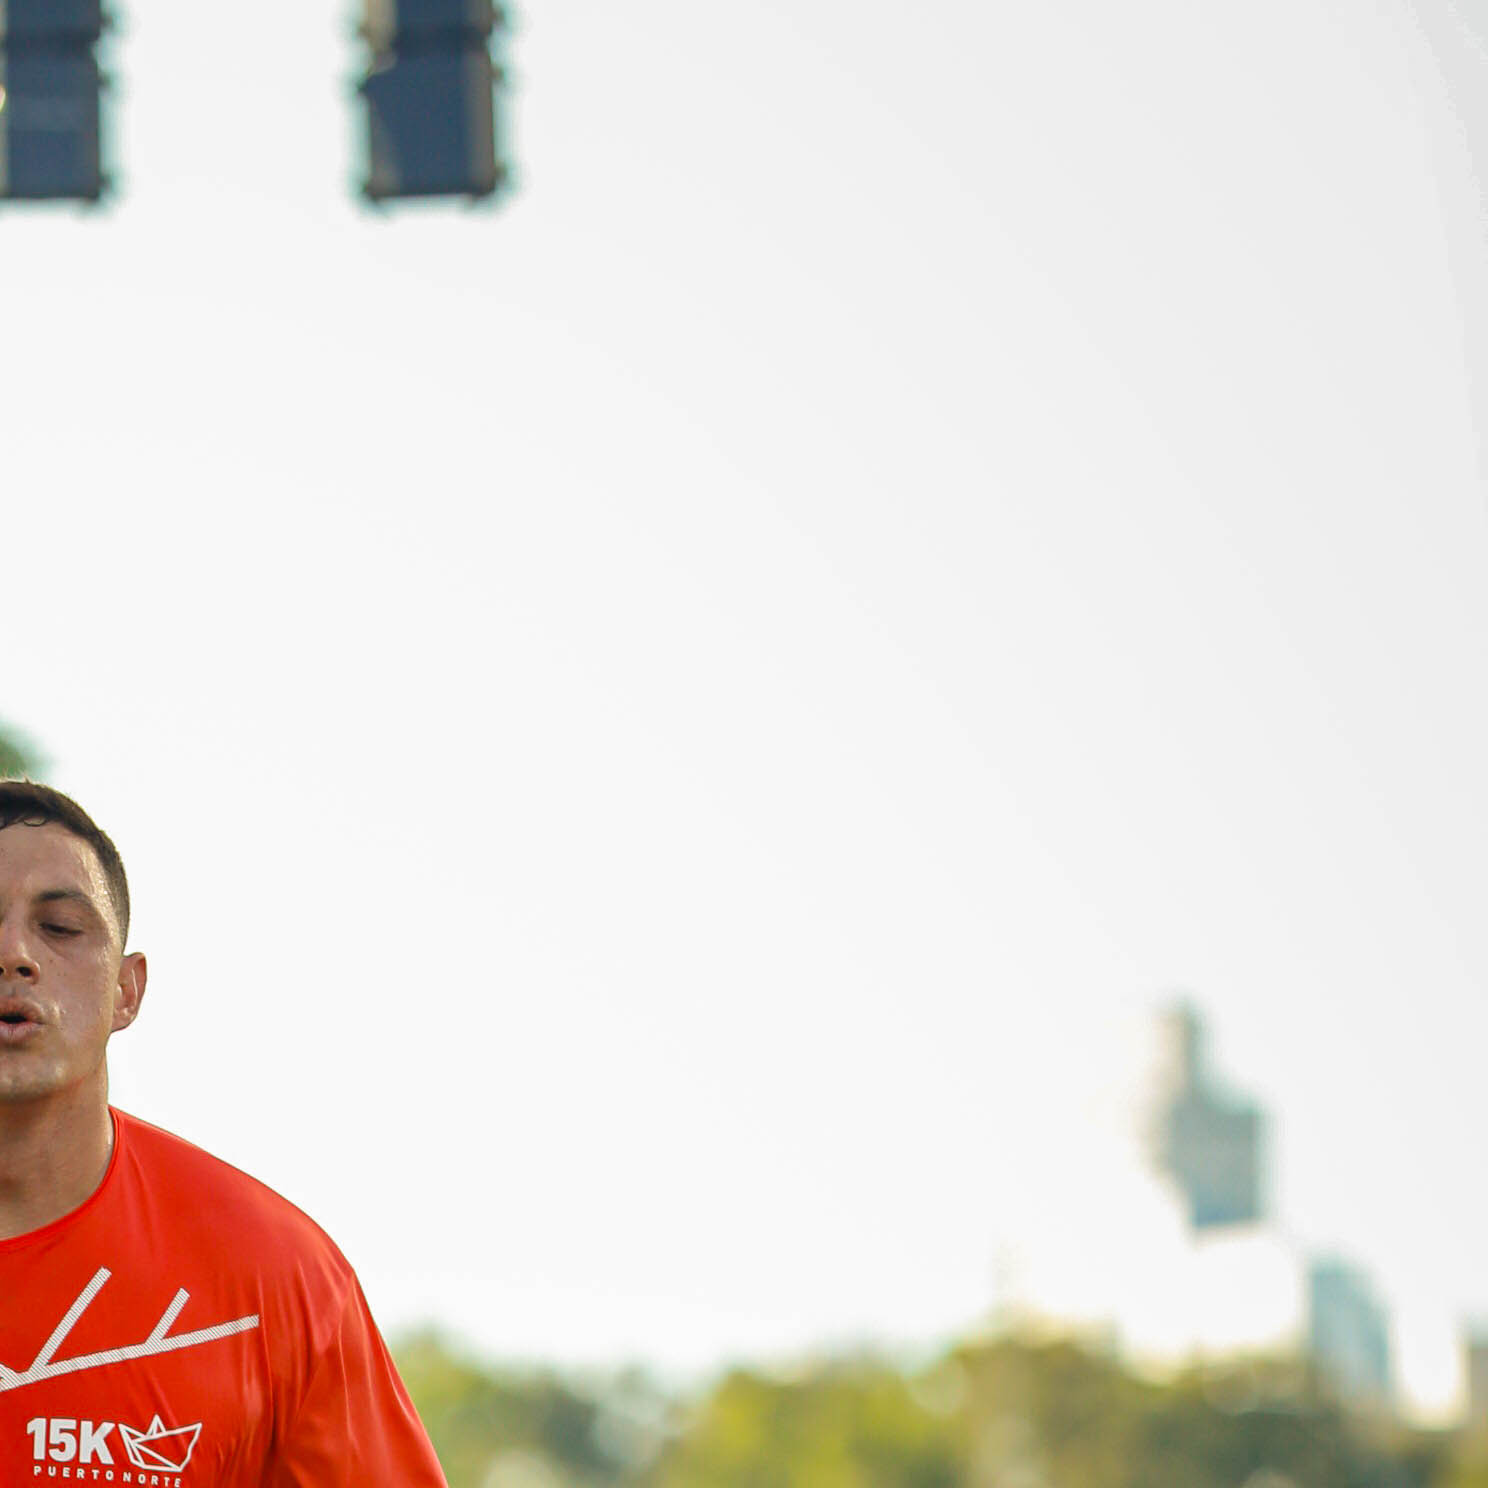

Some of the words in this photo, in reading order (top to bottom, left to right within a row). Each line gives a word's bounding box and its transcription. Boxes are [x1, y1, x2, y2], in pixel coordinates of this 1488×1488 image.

[26, 1417, 116, 1465] 15K
[33, 1465, 114, 1481] PUERTO
[122, 1471, 182, 1488] NORTE
